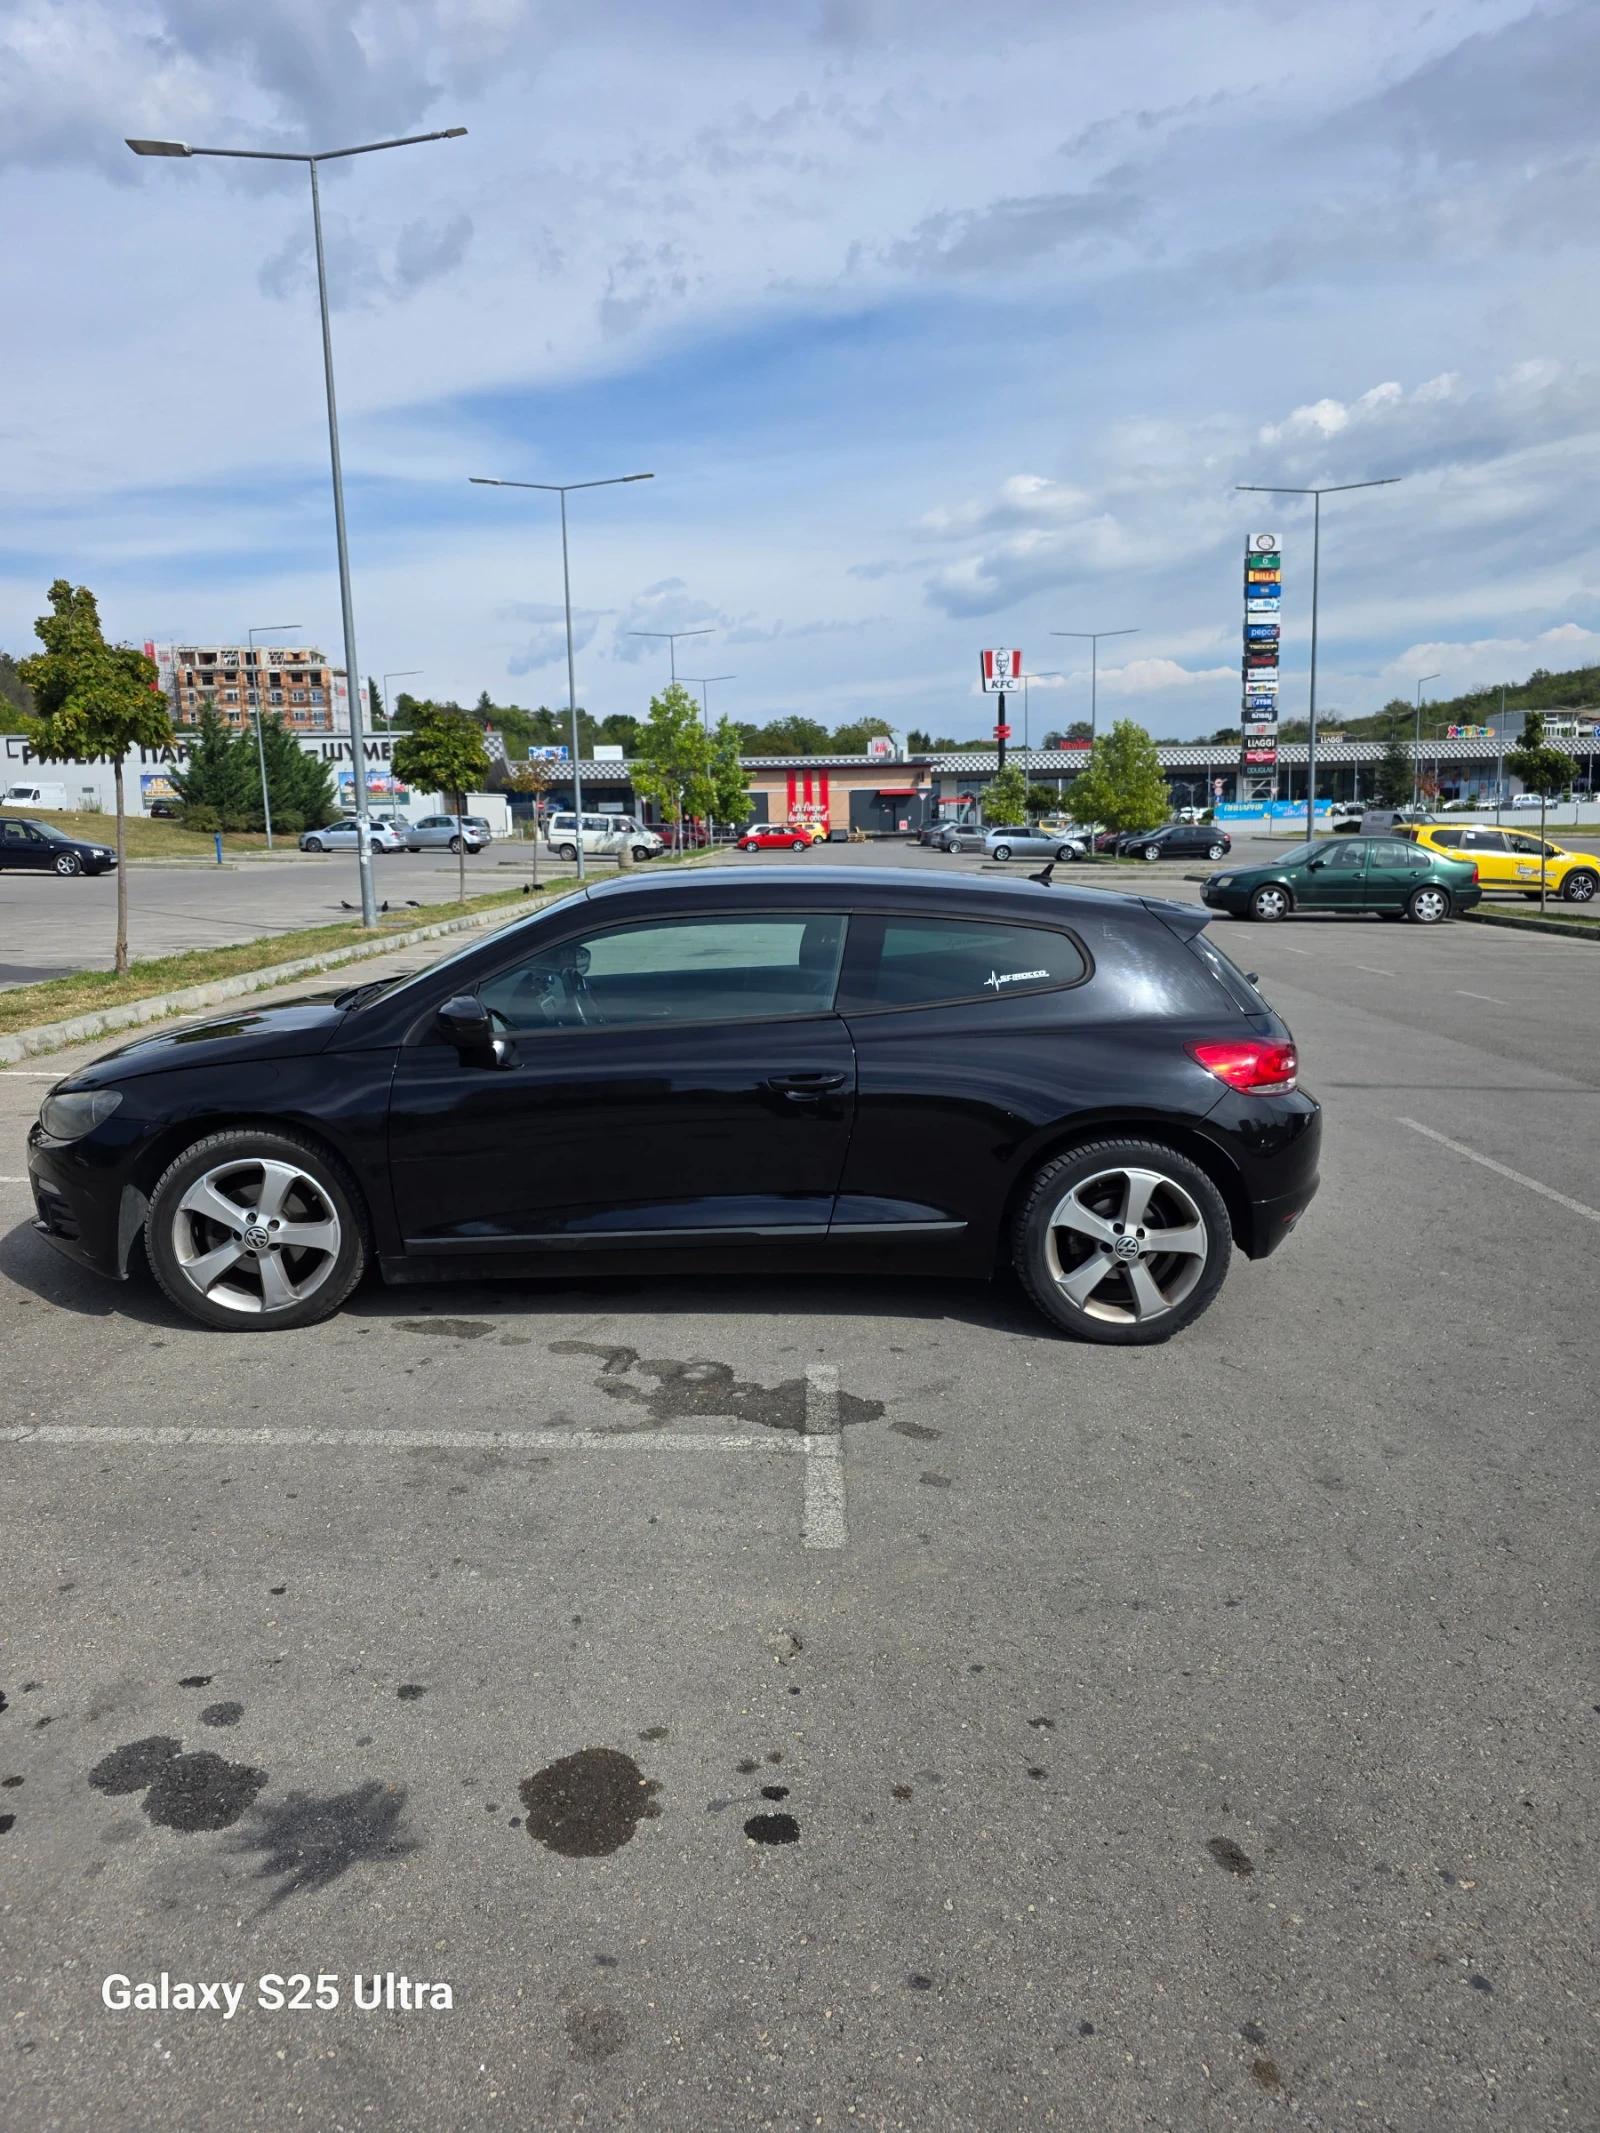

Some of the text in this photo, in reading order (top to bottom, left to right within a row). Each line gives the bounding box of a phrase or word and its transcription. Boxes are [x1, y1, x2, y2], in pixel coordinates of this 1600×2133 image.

[1254, 571, 1275, 581] BILLA
[1251, 629, 1277, 637] pepco
[991, 680, 1014, 689] KFC
[322, 742, 392, 761] ШУМЕ
[1246, 766, 1274, 774] DOUGLAS
